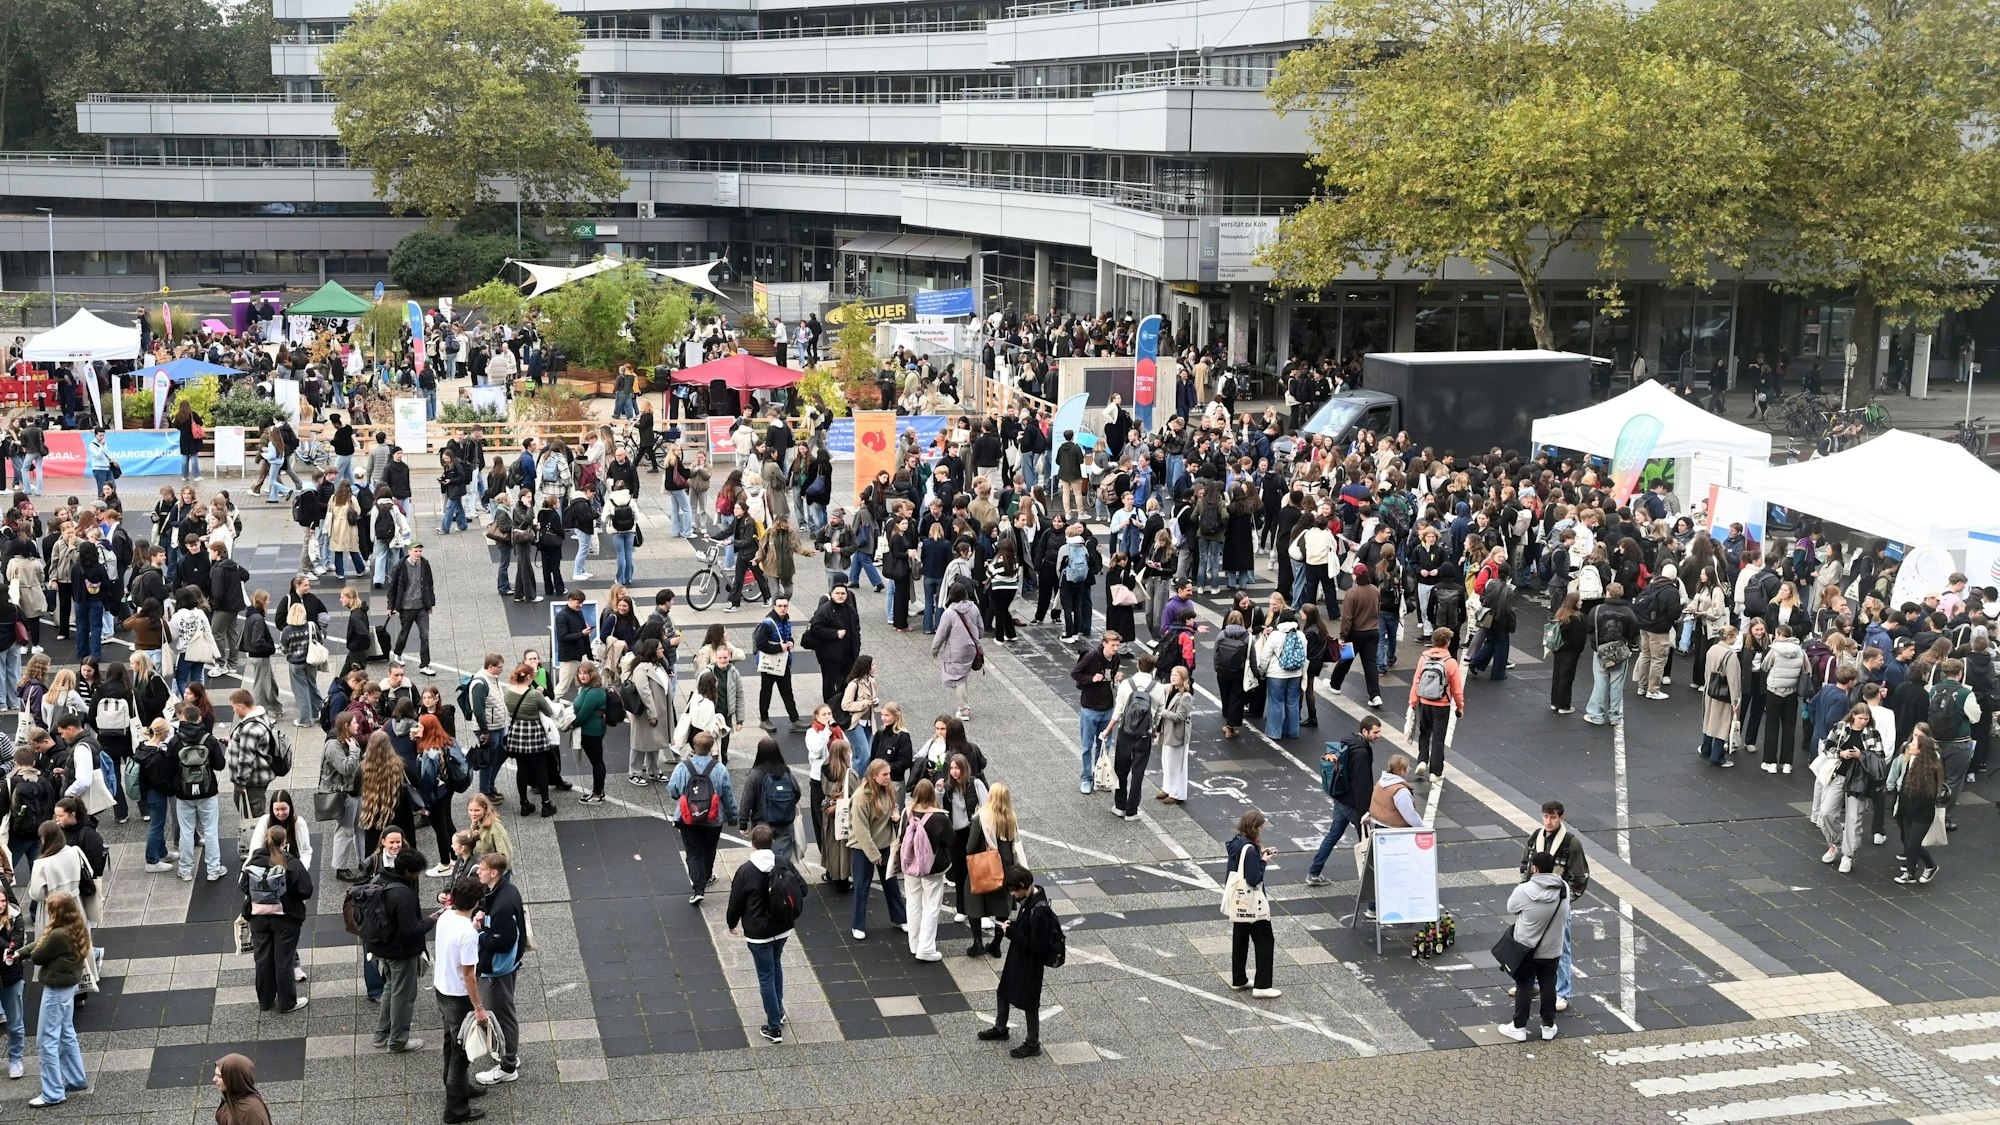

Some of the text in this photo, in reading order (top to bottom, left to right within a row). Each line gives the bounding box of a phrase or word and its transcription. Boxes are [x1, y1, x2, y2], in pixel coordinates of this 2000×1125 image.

[572, 225, 592, 234] AOK
[1203, 249, 1214, 257] 103
[855, 304, 907, 320] SAUER
[109, 447, 181, 459] INARGEBÄUDE
